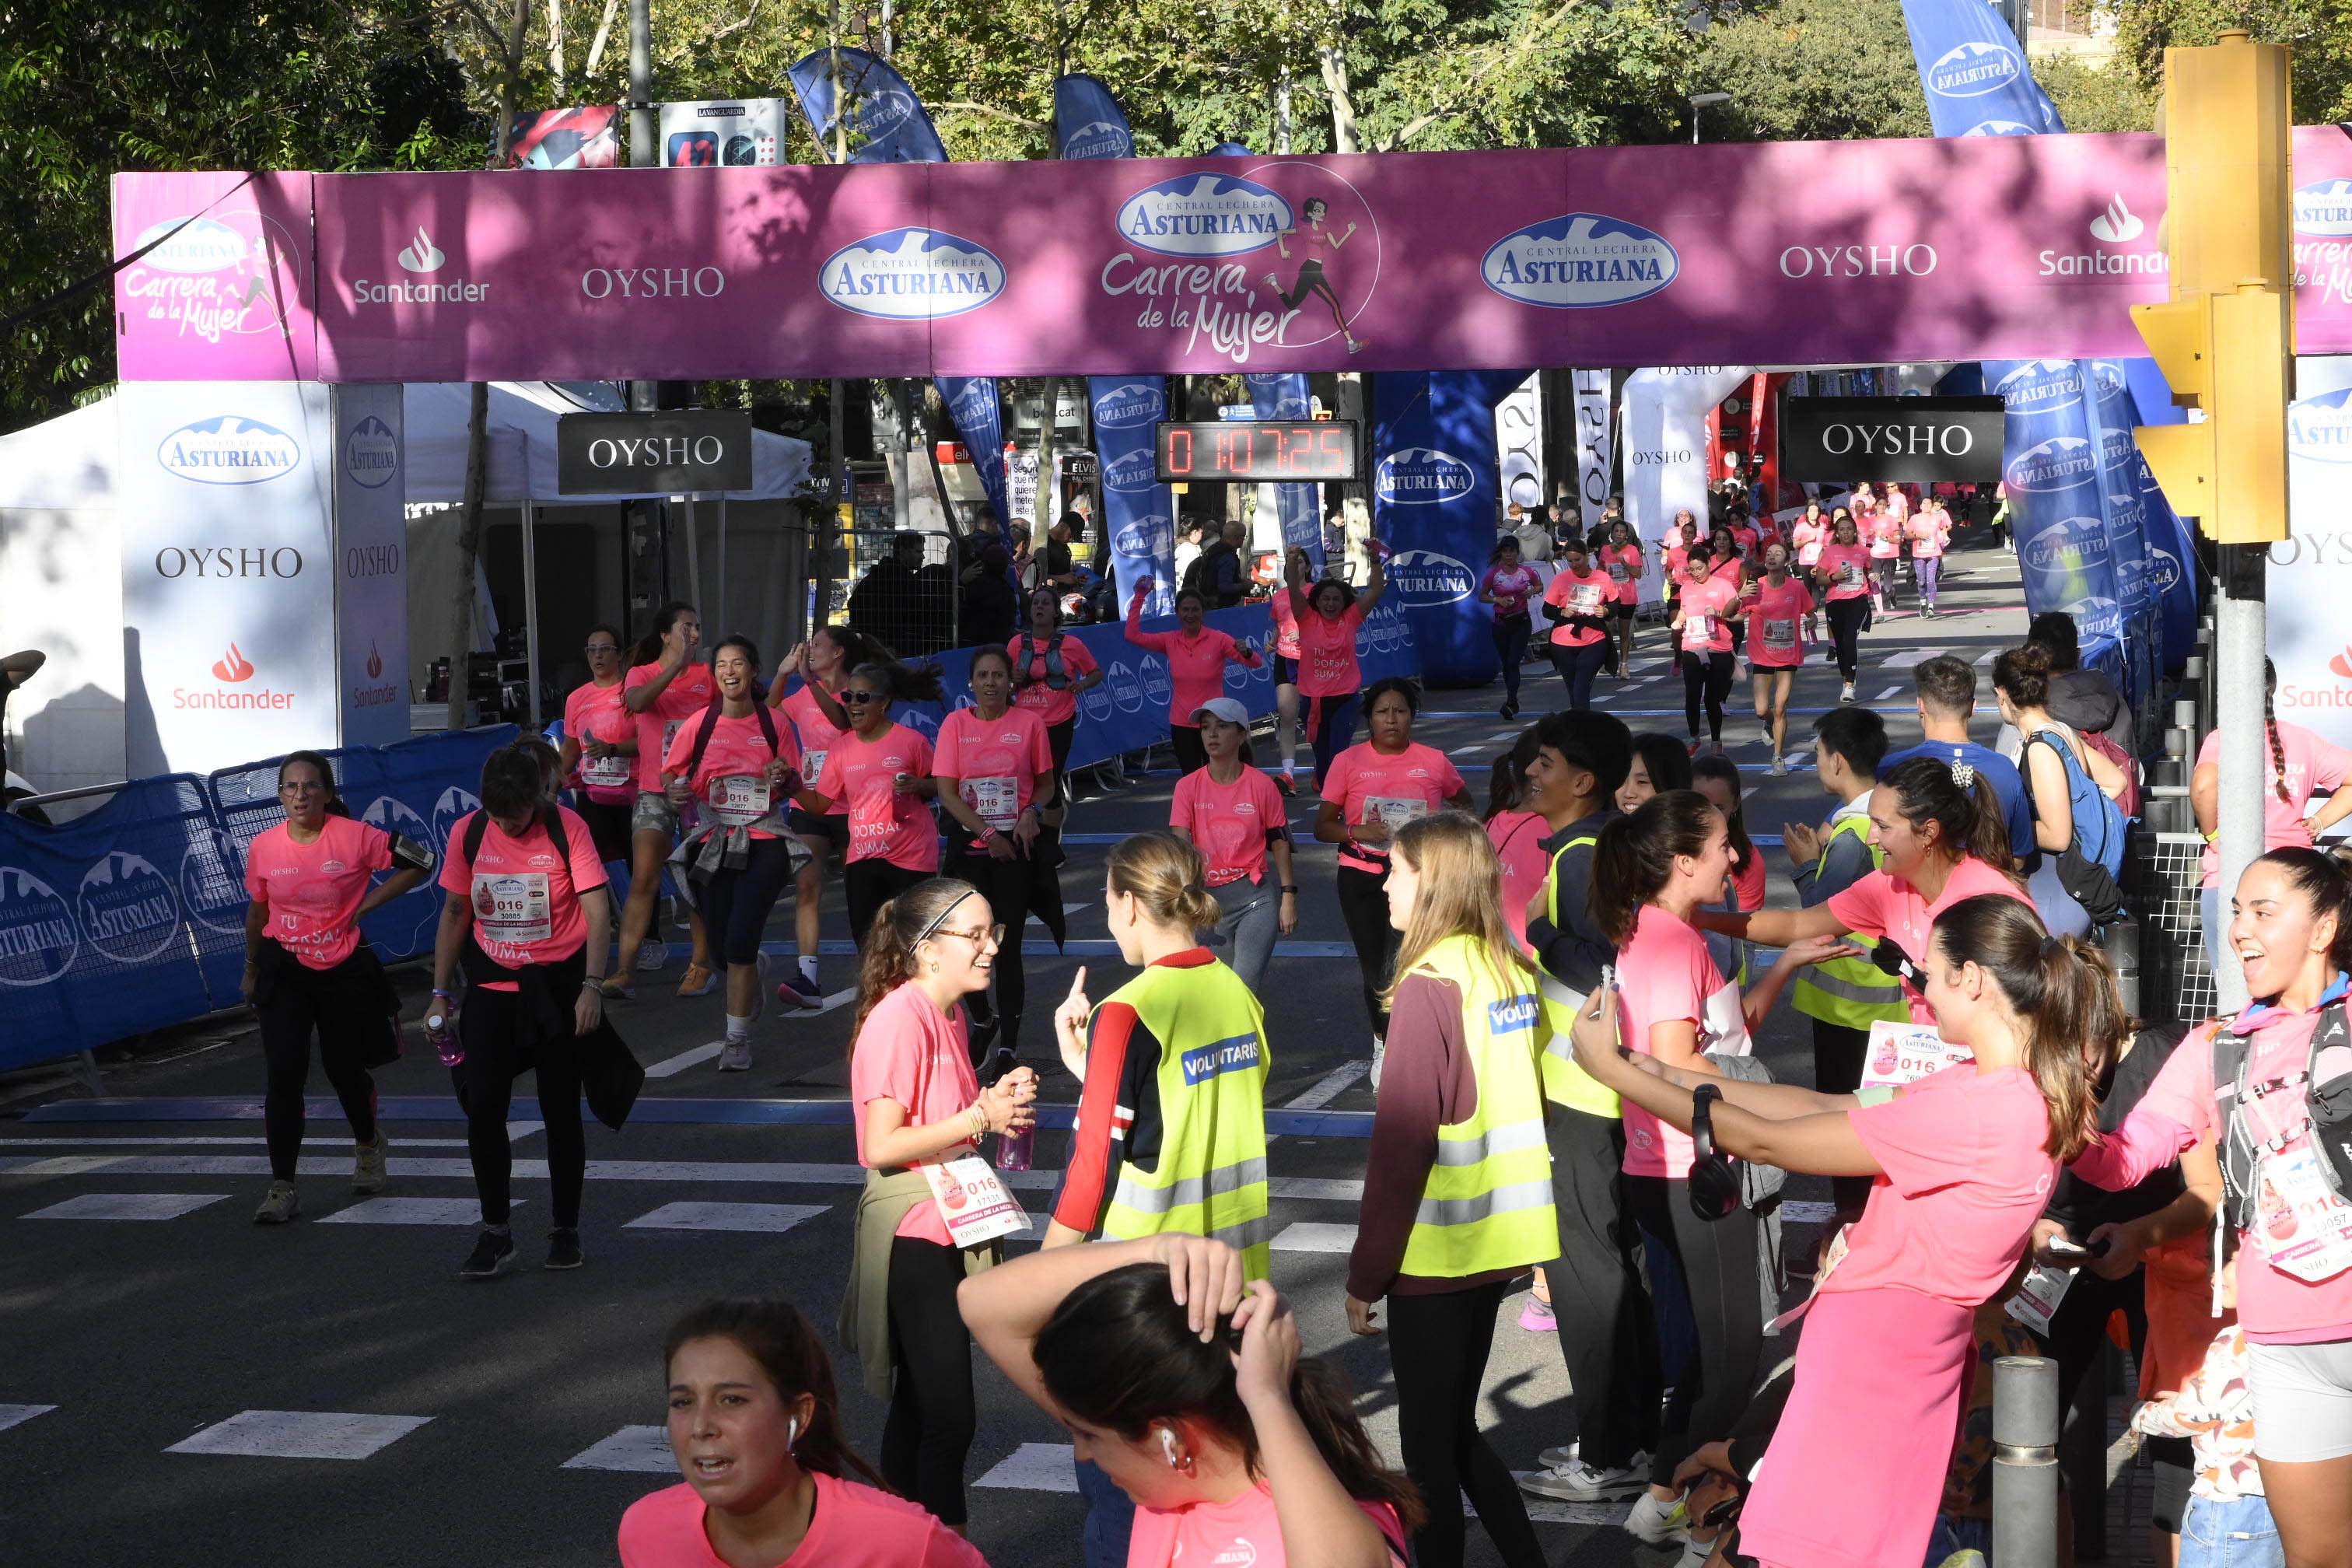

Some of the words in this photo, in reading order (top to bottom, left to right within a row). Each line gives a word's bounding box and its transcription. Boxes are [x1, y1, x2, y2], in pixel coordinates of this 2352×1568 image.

[1157, 201, 1213, 212] CENTRAL
[1218, 199, 1274, 210] LECHERA
[1129, 204, 1279, 236] ASTURIANA
[1526, 246, 1589, 257] CENTRAL
[1594, 244, 1657, 256] LECHERA
[1780, 243, 1937, 278] OYSHO
[2294, 242, 2352, 265] arrer
[861, 259, 921, 269] CENTRAL
[1101, 253, 1247, 296] Carrera
[1496, 250, 1664, 285] ASTURIANA
[124, 268, 219, 298] Carrera
[581, 267, 725, 299] OYSHO
[833, 262, 992, 296] ASTURIANA
[355, 278, 490, 305] Santander
[149, 299, 165, 320] de
[168, 296, 181, 320] la
[179, 295, 252, 344] Mujer
[1137, 297, 1164, 328] de
[1169, 296, 1189, 328] la
[1185, 291, 1302, 364] Mujer
[1822, 424, 1972, 456] OYSHO
[170, 441, 290, 467] ASTURIANA
[349, 443, 395, 471] ASTURIANA
[588, 436, 723, 469] OYSHO
[1633, 450, 1691, 465] OYSHO
[1072, 463, 1097, 474] ELVIS
[1378, 470, 1468, 492] ASTURIANA
[156, 547, 303, 579] OYSHO
[348, 544, 399, 579] OYSHO
[1395, 577, 1468, 593] TURIANA
[1314, 646, 1325, 656] TU
[173, 688, 295, 709] Santander
[354, 684, 398, 709] Santander
[730, 793, 749, 802] 016
[979, 798, 998, 807] 016
[855, 821, 901, 838] DORSAL
[856, 839, 890, 856] SUMA
[271, 866, 299, 877] OYSHO
[497, 900, 523, 910] 016
[86, 894, 176, 940] ASTURIANA
[280, 914, 297, 929] TU
[483, 939, 531, 959] SUMA
[1904, 1040, 1941, 1052] ASTURIANA
[1185, 1041, 1258, 1076] VOLUNTARIS
[1901, 1058, 1936, 1073] 016
[967, 1177, 997, 1195] 016
[976, 1193, 1001, 1207] 17131
[957, 1212, 983, 1224] CARRERA
[961, 1225, 989, 1239] OYSHO
